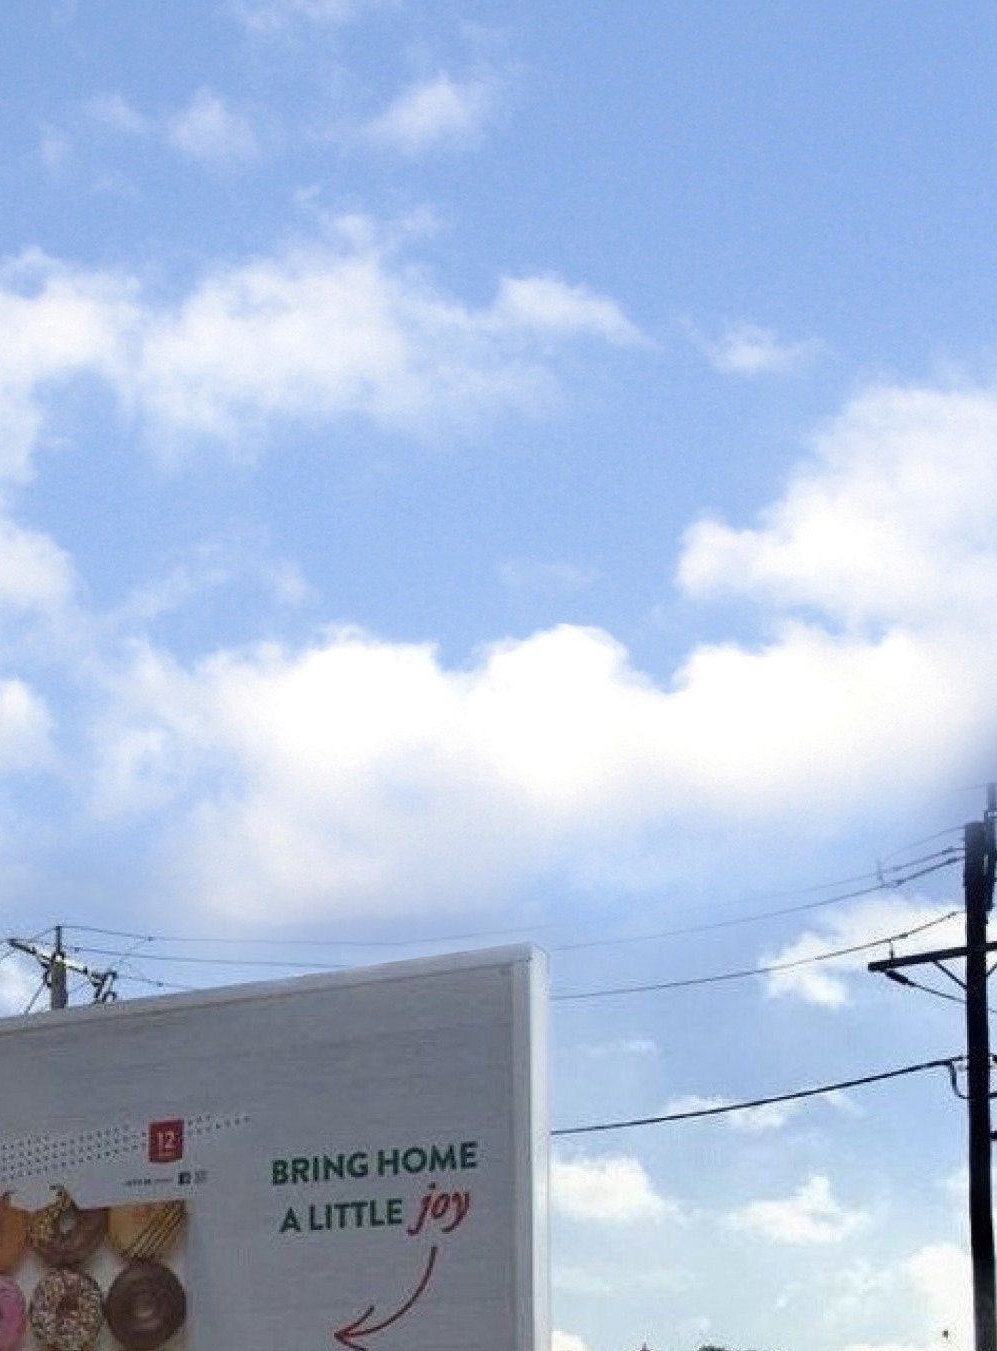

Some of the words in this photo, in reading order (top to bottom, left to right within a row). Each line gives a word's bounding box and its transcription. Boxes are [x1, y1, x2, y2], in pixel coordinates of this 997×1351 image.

[272, 1152, 369, 1186] BRING
[377, 1141, 479, 1177] HOME
[279, 1206, 301, 1233] A
[309, 1199, 403, 1232] LITTLE
[407, 1182, 470, 1236] joy
